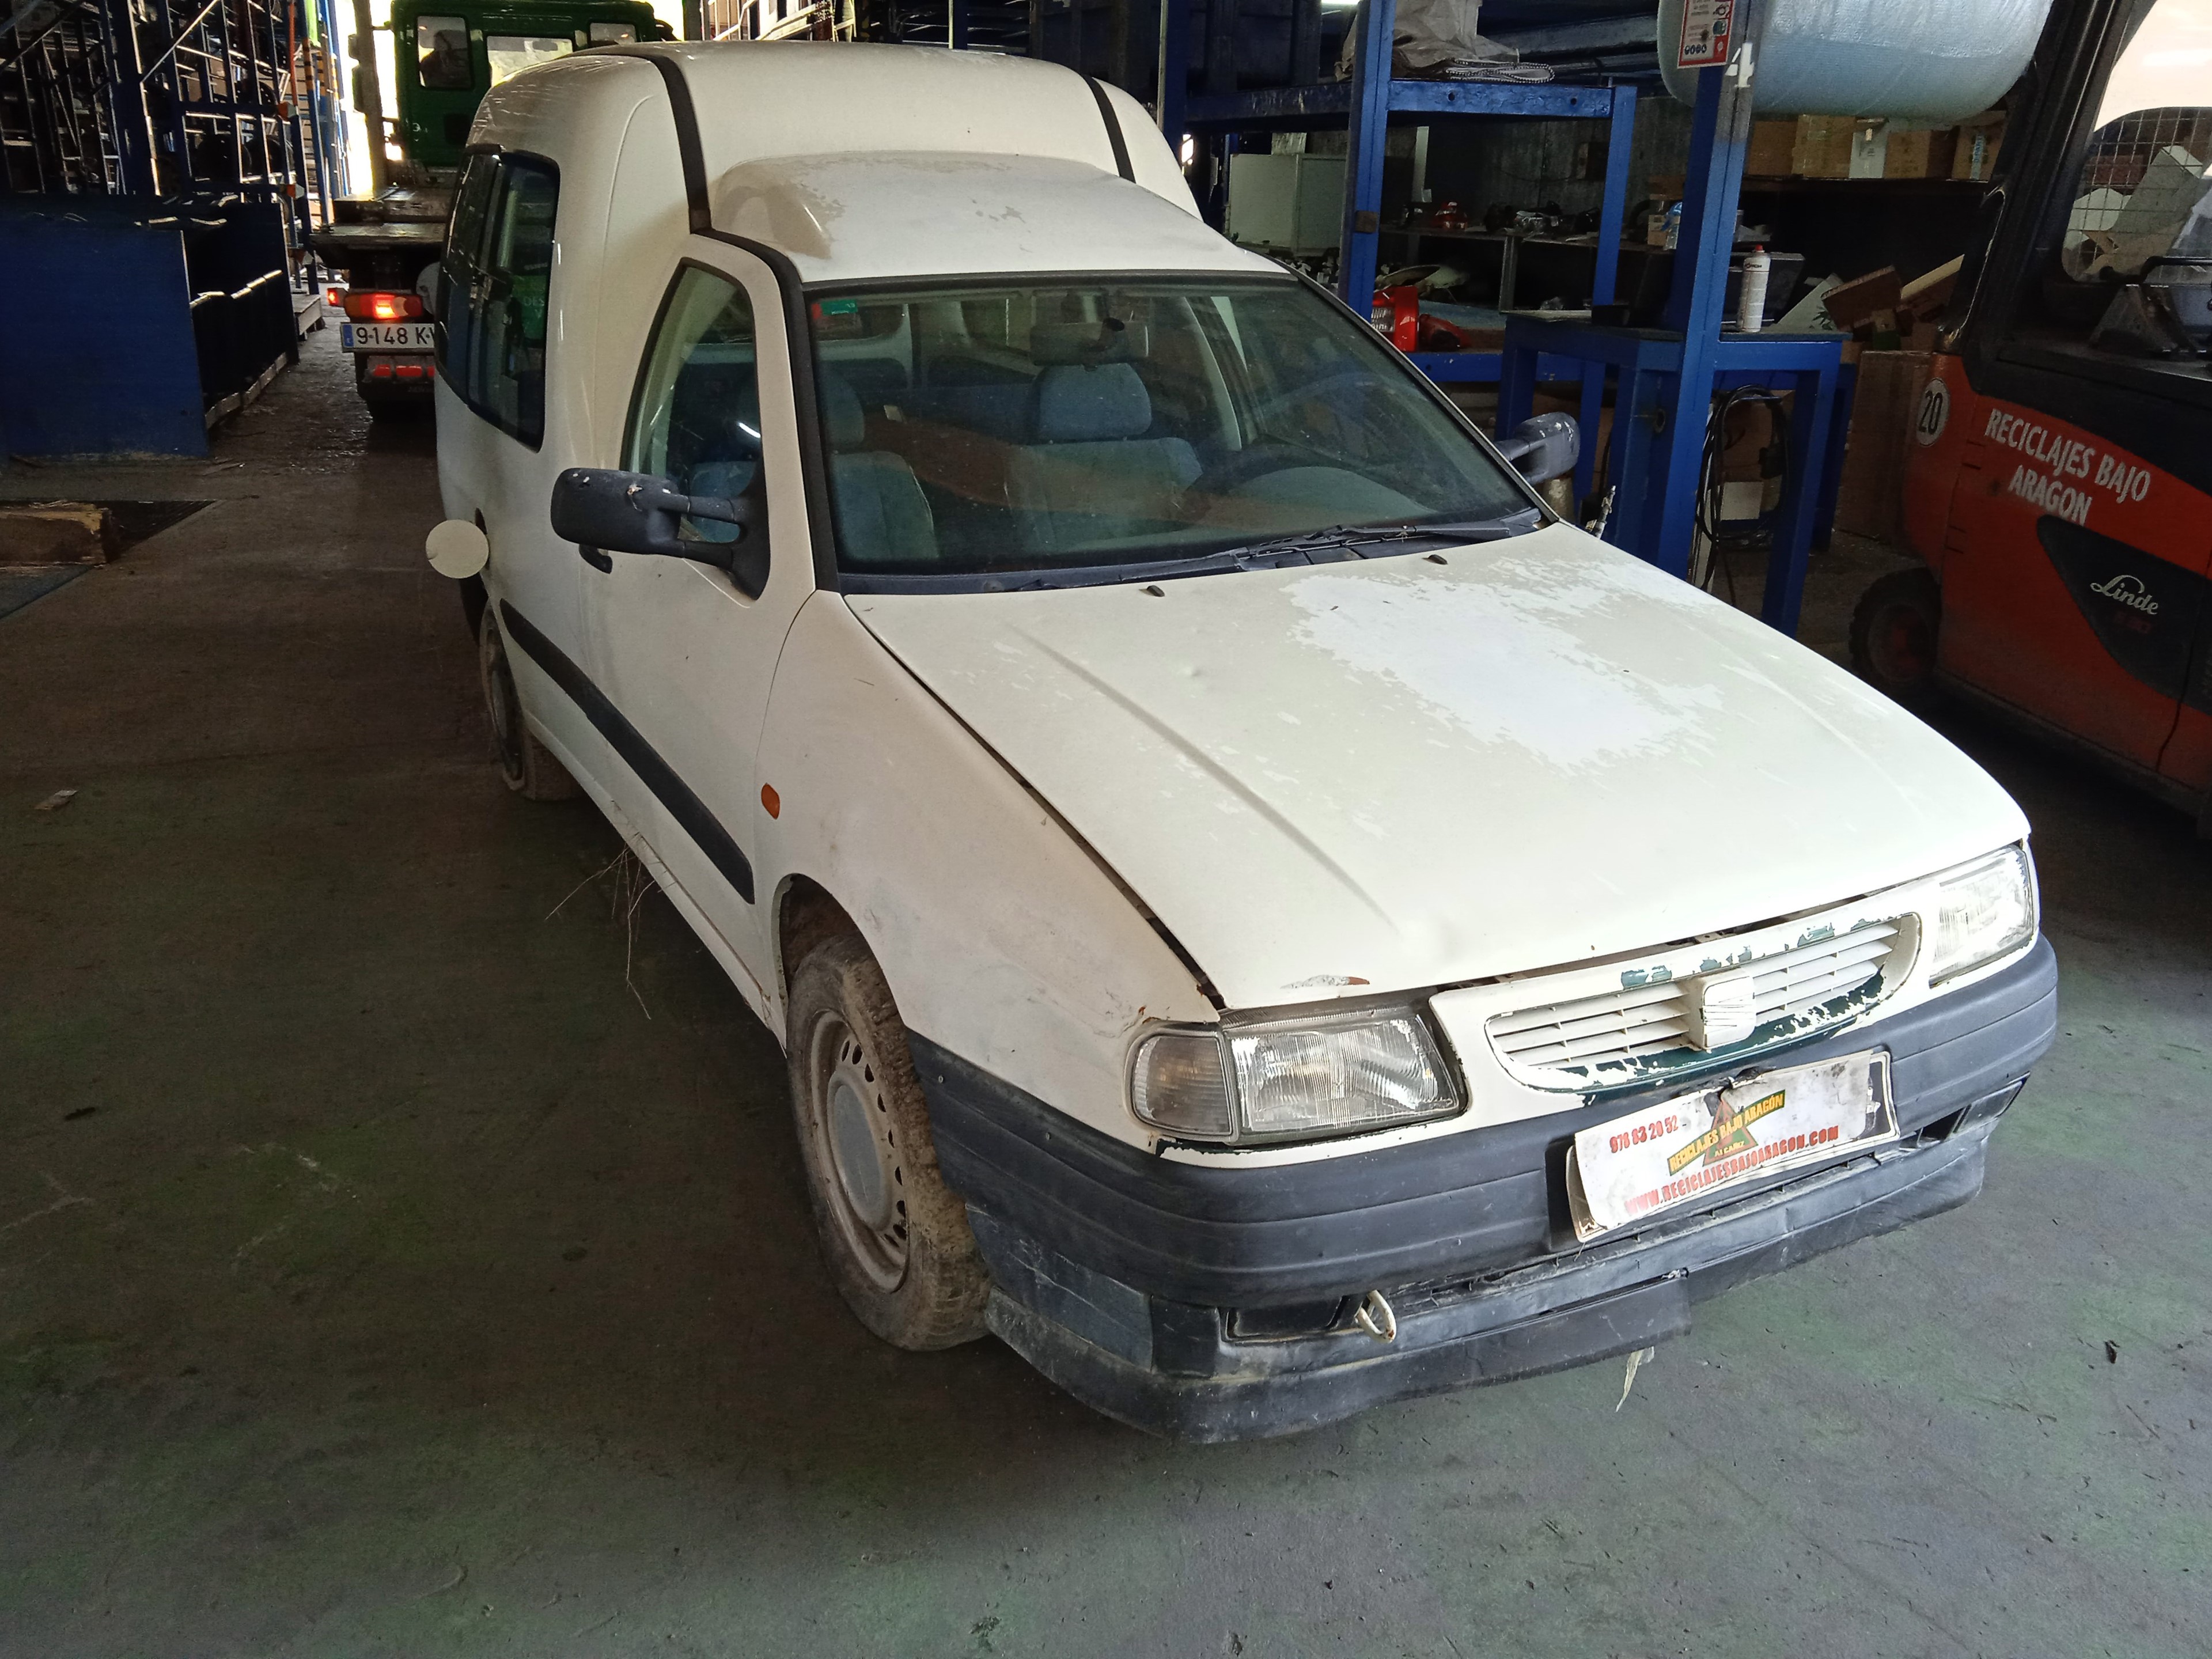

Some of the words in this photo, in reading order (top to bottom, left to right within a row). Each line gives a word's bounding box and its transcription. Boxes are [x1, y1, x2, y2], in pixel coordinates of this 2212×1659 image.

[355, 327, 409, 344] 9148
[415, 327, 435, 345] K
[1919, 390, 1943, 435] 20
[1984, 408, 2096, 479] RECICLAJES
[2094, 453, 2151, 503] BAJO
[2007, 464, 2093, 527] ARAGON
[2090, 574, 2160, 615] Linde
[1609, 1132, 1630, 1153] 978
[1631, 1126, 1647, 1145] 83
[1648, 1120, 1664, 1140] 20
[1664, 1115, 1679, 1134] 52
[1669, 1128, 1719, 1172] RECICLAJES
[1719, 1114, 1744, 1139] BAJO
[1744, 1093, 1784, 1124] ARAGÓN
